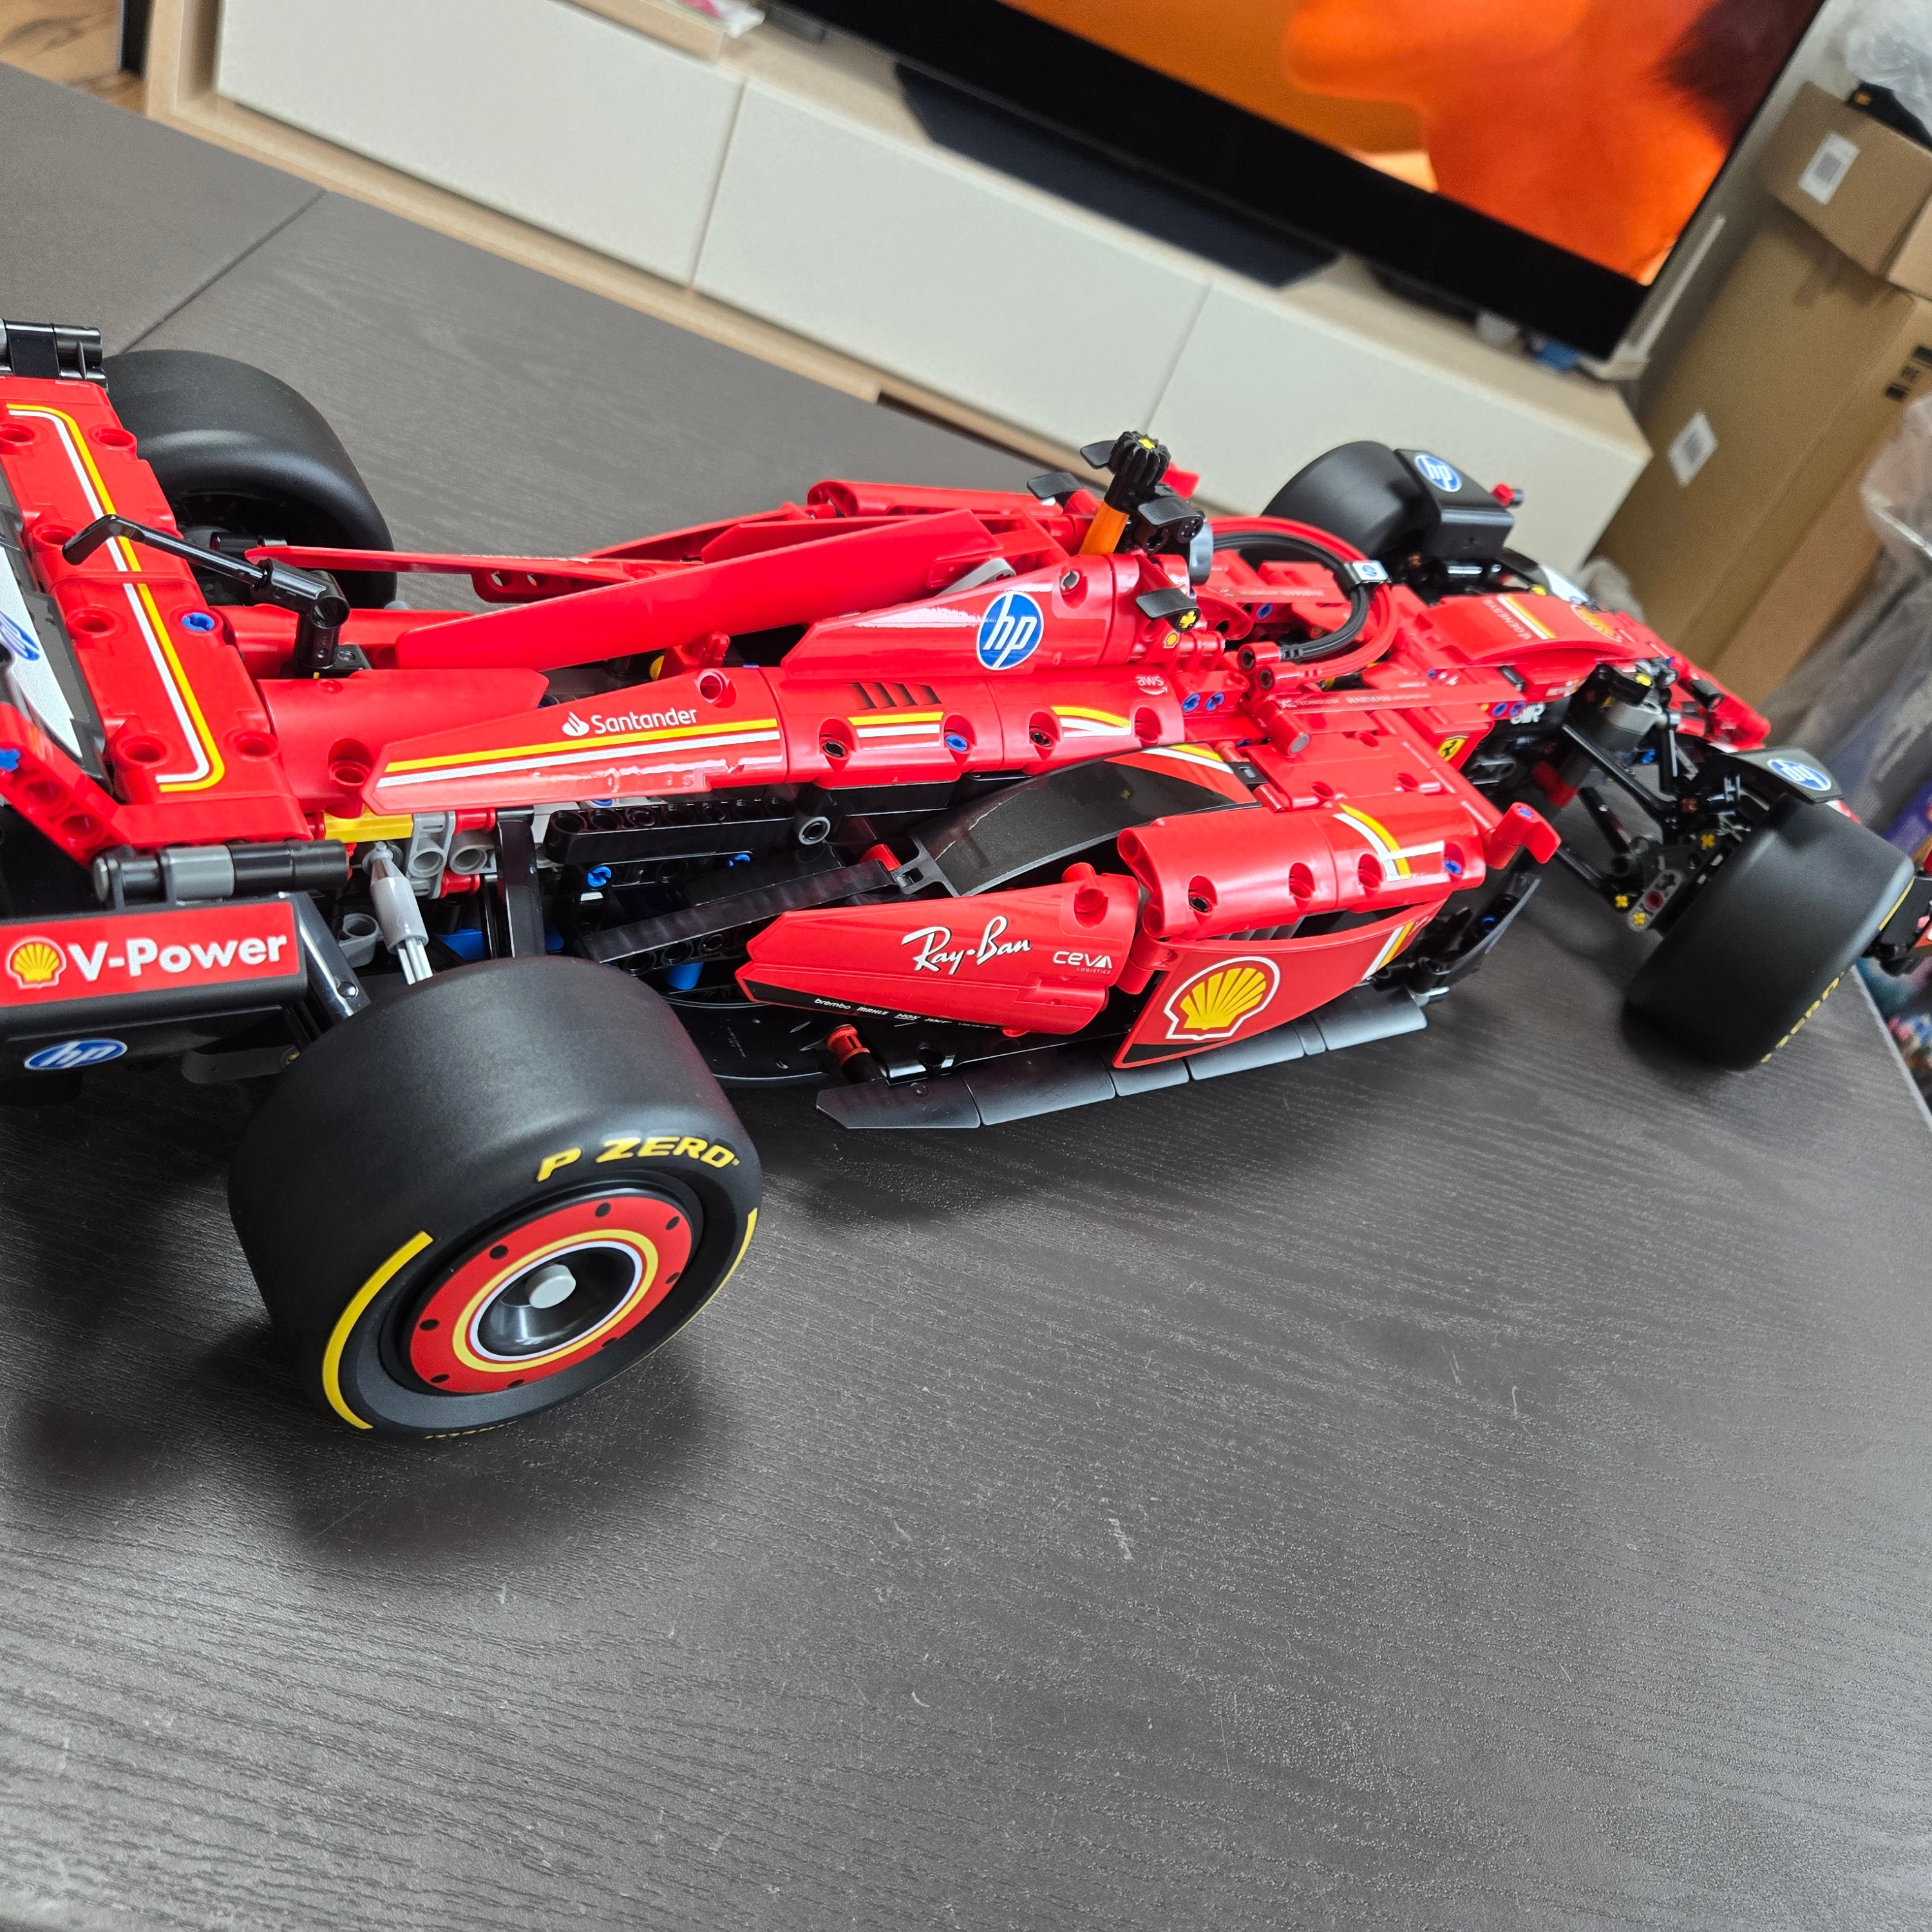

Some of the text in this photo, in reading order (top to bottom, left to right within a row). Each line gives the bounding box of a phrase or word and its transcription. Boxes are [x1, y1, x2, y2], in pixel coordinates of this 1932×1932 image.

[1418, 454, 1456, 491] hp
[981, 591, 1040, 670] hp
[1135, 675, 1164, 687] aws
[591, 708, 697, 734] Santander
[1772, 760, 1828, 790] hp
[67, 934, 287, 982] V-Power
[901, 916, 1032, 974] Ray-Ban
[1076, 967, 1112, 975] LOGISTICS
[814, 998, 851, 1010] brembo
[32, 1039, 121, 1069] hp
[536, 1135, 735, 1182] P ZERO
